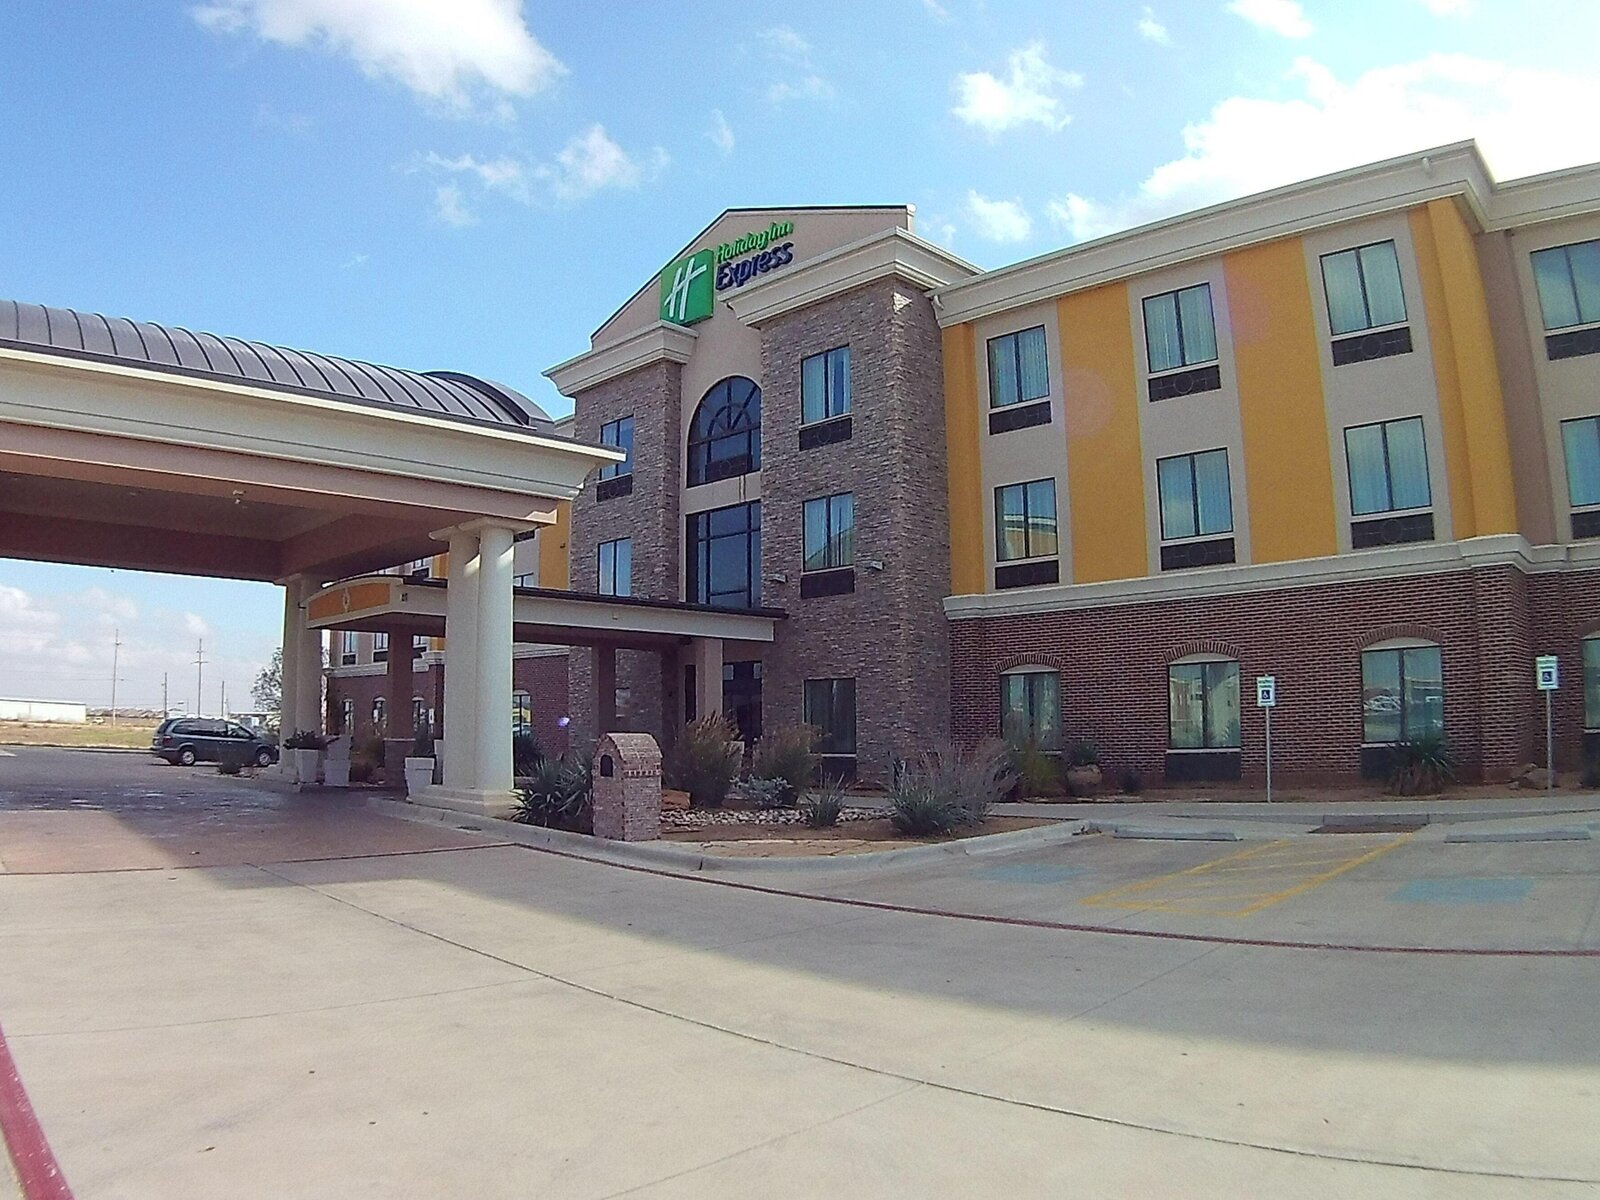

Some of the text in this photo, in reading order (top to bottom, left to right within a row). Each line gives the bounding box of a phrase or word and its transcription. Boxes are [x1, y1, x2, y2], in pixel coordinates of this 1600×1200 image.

[716, 221, 794, 263] Holiday Inn
[716, 242, 794, 290] Express
